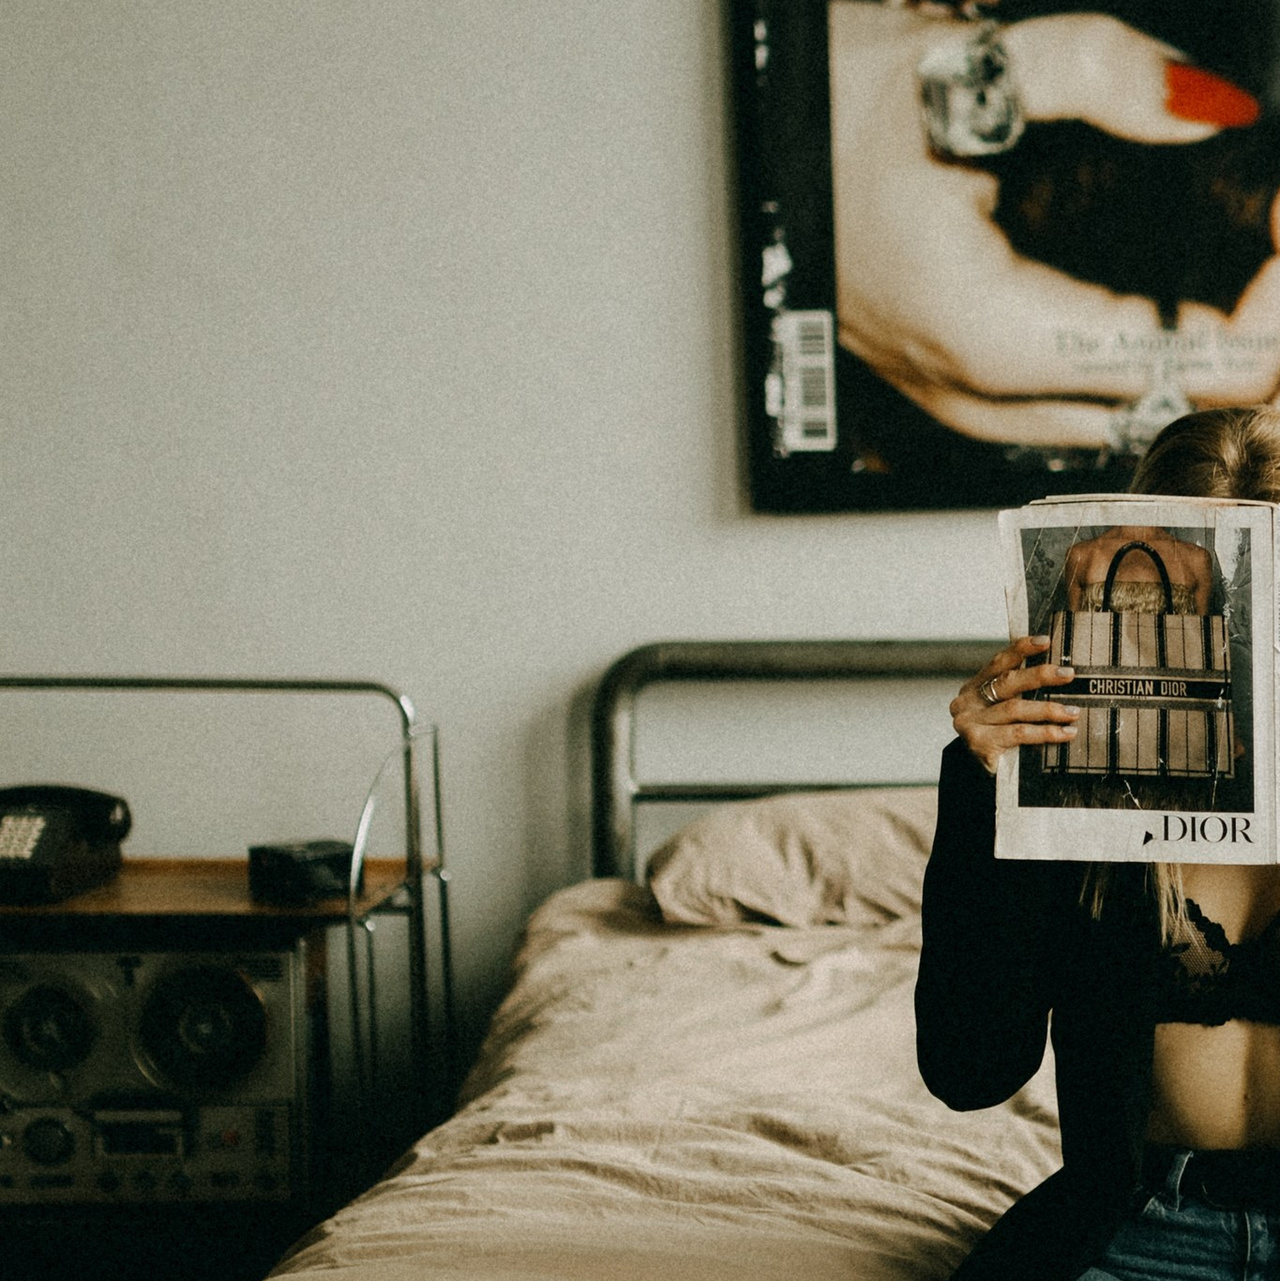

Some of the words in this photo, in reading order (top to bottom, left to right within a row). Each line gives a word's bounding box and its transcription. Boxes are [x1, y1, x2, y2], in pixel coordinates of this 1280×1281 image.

[1089, 679, 1154, 695] CHRISTIAN
[1160, 681, 1188, 697] DIOR
[1162, 815, 1254, 843] DIOR
